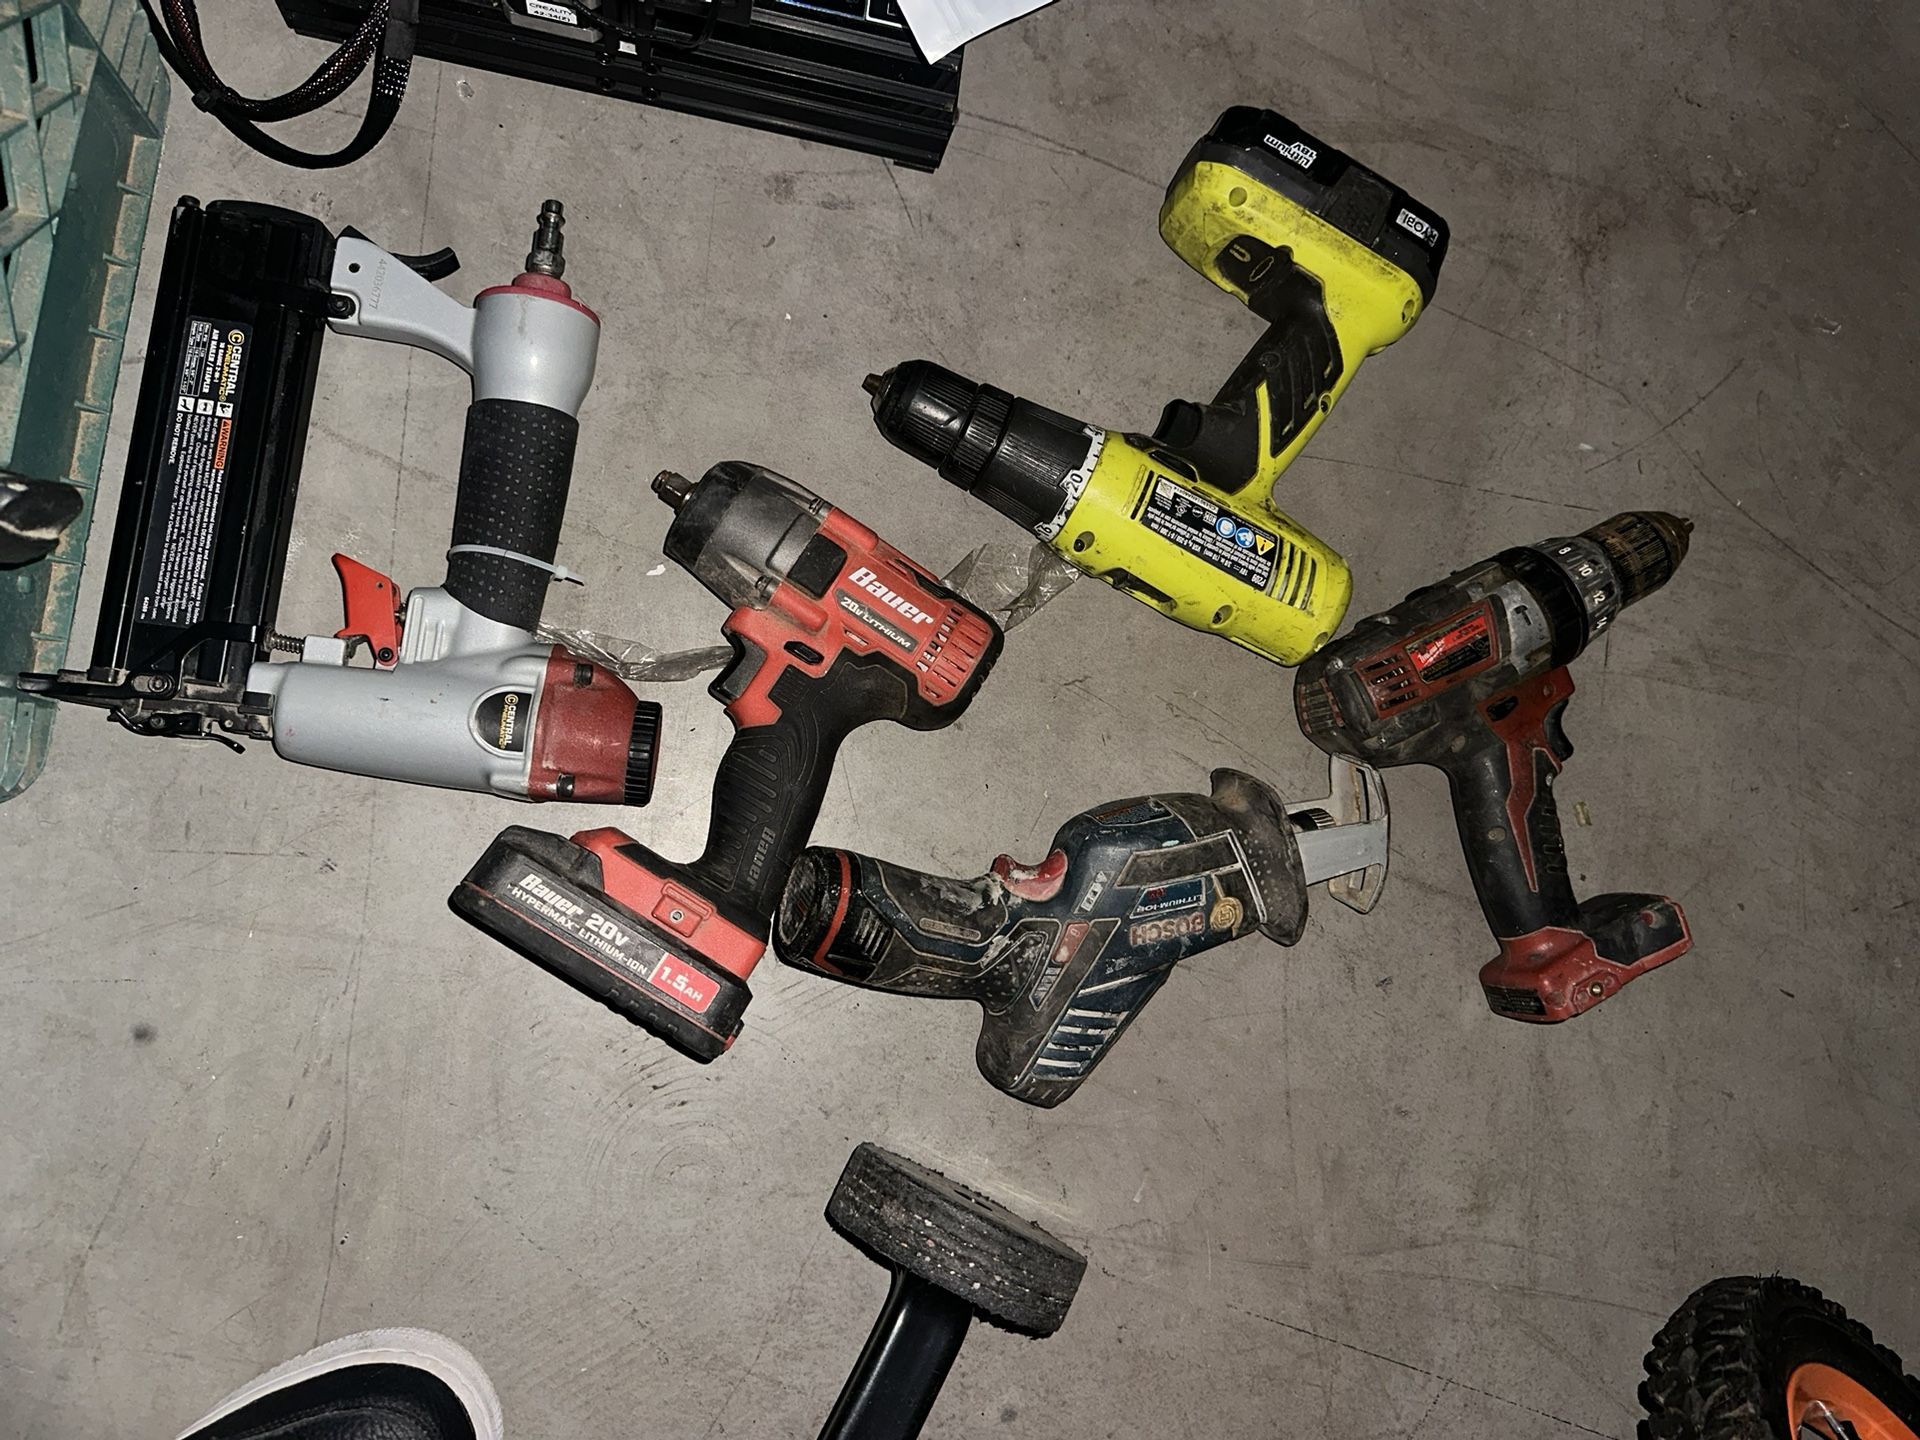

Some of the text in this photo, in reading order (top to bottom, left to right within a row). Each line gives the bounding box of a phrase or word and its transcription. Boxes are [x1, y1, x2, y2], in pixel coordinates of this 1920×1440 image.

[529, 3, 572, 16] CREALITY
[1264, 135, 1313, 168] Lithium
[1292, 141, 1316, 160] 18V
[1400, 213, 1439, 246] RYOBI
[211, 329, 219, 339] AIR
[207, 340, 216, 361] NAILER
[201, 366, 212, 393] STAPLER
[225, 345, 241, 396] CENTRAL
[173, 423, 181, 436] NOT
[184, 414, 192, 429] bottled
[190, 414, 198, 433] NEVER
[209, 427, 217, 442] others
[168, 437, 178, 465] REMOVE.
[216, 427, 229, 467] WARNING
[176, 450, 185, 473] Explosion
[197, 457, 205, 473] fingers
[181, 469, 189, 488] yourself
[188, 464, 196, 486] triggering
[194, 474, 202, 488] AWAY
[208, 468, 216, 491] warnings
[176, 494, 184, 509] others
[184, 487, 192, 505] method
[189, 501, 197, 516] trigger
[209, 493, 219, 521] understand
[193, 499, 204, 535] ANSI-approved
[164, 520, 173, 542] Deflector
[198, 528, 206, 546] DEATH
[176, 536, 184, 551] Check
[204, 533, 212, 549] labels
[1558, 546, 1572, 555] 8
[168, 542, 176, 560] NEVER
[187, 551, 195, 570] goggles
[173, 552, 181, 570] manual
[179, 556, 187, 577] fasteners
[193, 553, 202, 577] SERIOUS
[1578, 563, 1593, 577] 10
[157, 562, 165, 581] exhaust
[163, 571, 171, 589] oxygen
[1250, 572, 1266, 586] P209
[168, 578, 176, 600] triggering
[196, 582, 204, 600] Failure
[848, 566, 934, 626] Bauer
[1592, 590, 1606, 605] 12
[180, 592, 188, 609] shields
[185, 600, 194, 624] Operators
[863, 611, 912, 648] LITHIUM
[1596, 616, 1608, 629] 14
[506, 705, 516, 744] CENTRAL
[519, 873, 630, 947] Bauer 20v
[1137, 894, 1203, 912] LITHIUM-ION
[1131, 912, 1204, 945] BOSCH
[578, 926, 648, 976] LITHIUM-ION
[661, 965, 704, 1002] 1.5AH
